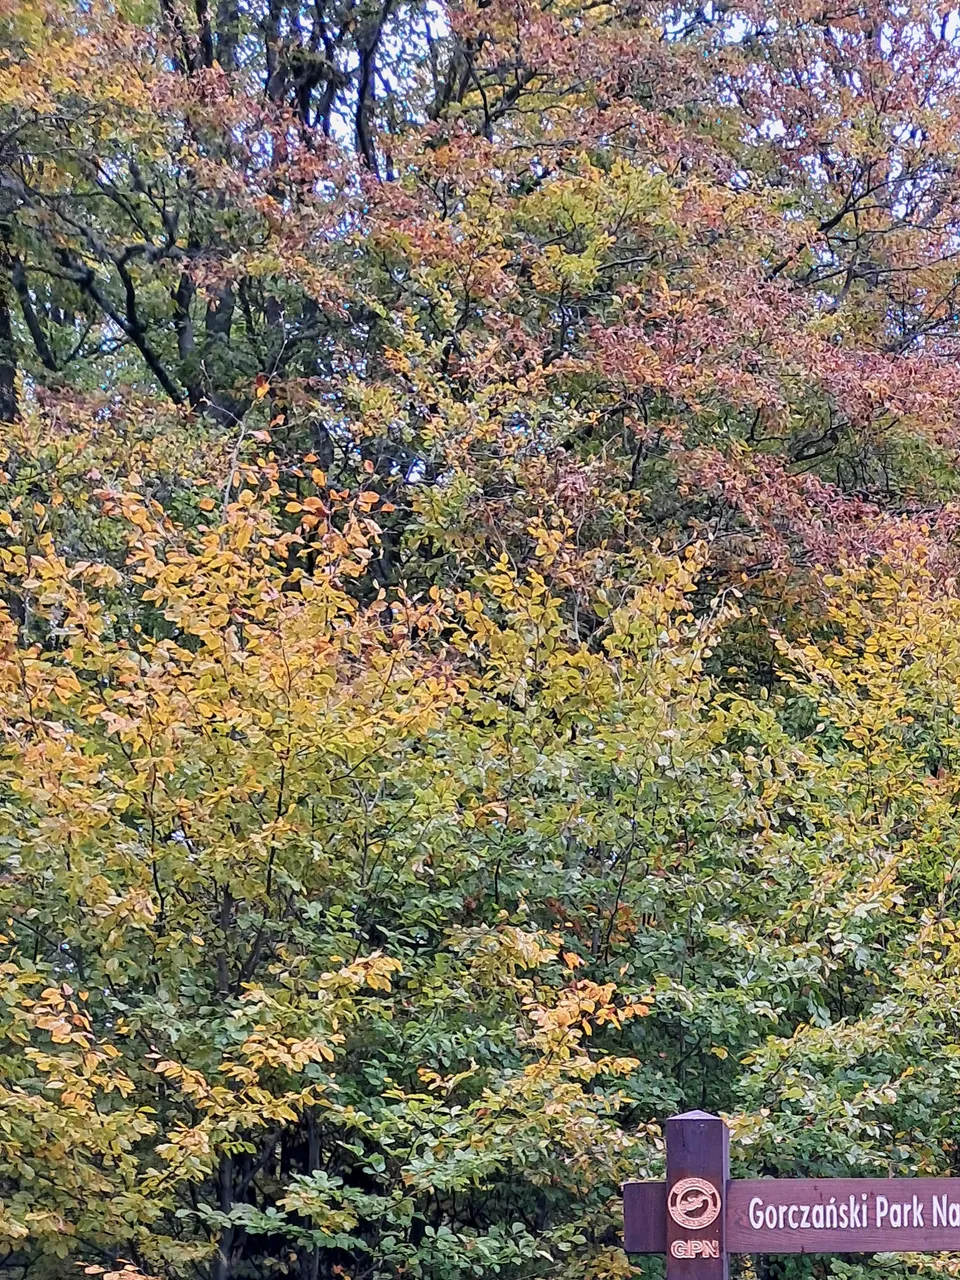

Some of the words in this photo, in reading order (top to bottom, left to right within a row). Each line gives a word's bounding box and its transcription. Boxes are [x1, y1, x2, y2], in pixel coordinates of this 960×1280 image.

[748, 1192, 868, 1230] Gorczański
[875, 1194, 925, 1229] Park
[670, 1239, 721, 1259] GPN
